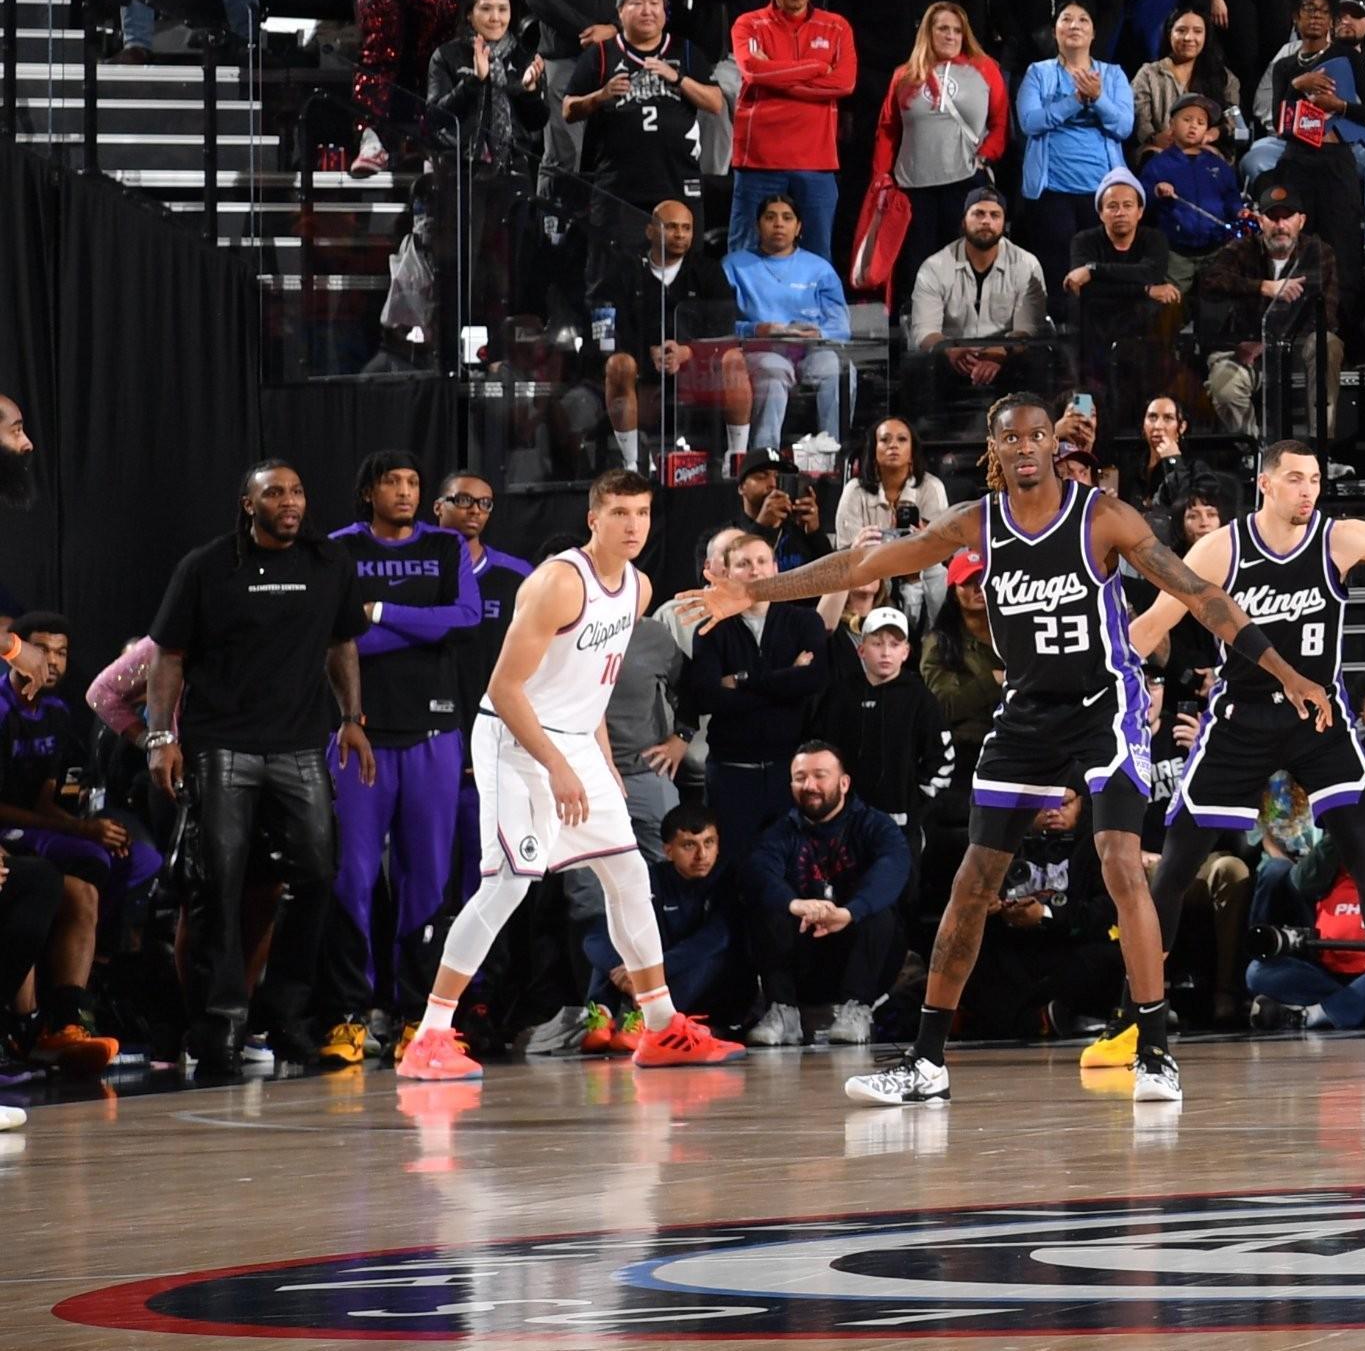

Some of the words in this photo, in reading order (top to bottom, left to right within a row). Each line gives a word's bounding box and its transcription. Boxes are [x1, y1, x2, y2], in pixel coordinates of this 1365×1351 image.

[642, 105, 659, 133] 2
[356, 559, 441, 578] KINGS
[991, 570, 1089, 616] Kings
[1235, 583, 1328, 625] Kings
[576, 610, 634, 652] Clippers
[1033, 614, 1091, 655] 23
[1300, 621, 1326, 657] 8
[600, 651, 622, 687] 10
